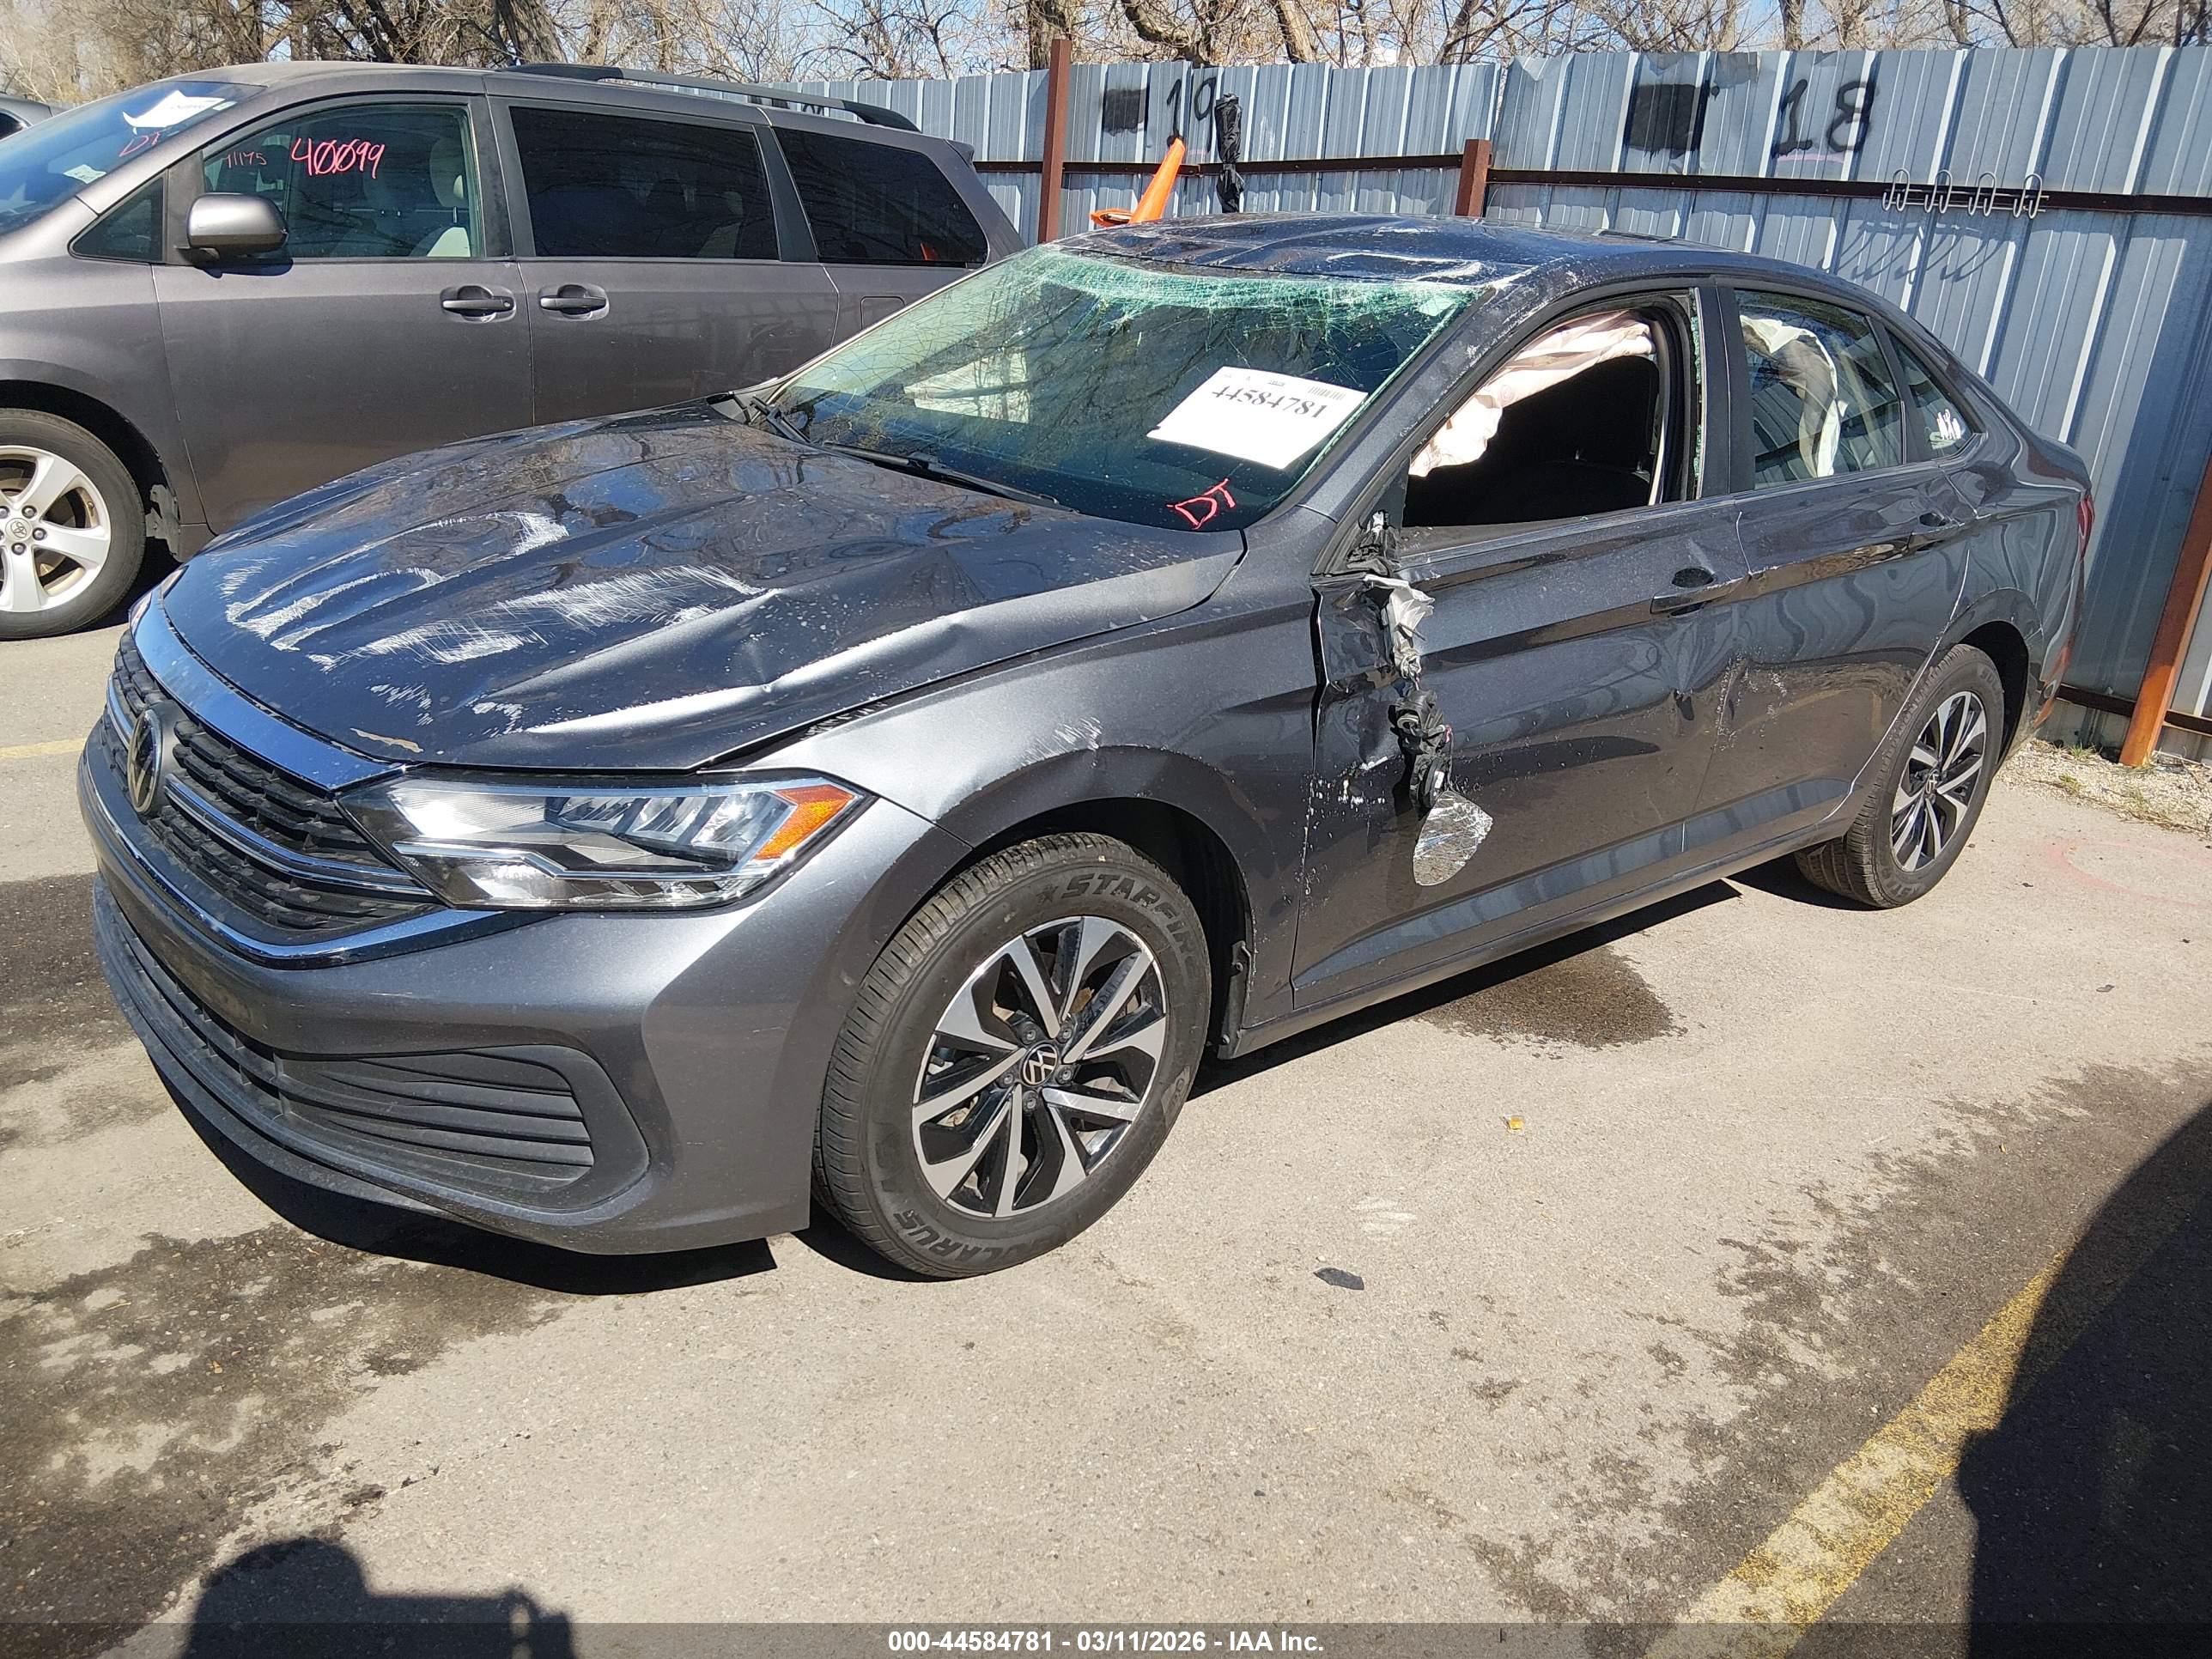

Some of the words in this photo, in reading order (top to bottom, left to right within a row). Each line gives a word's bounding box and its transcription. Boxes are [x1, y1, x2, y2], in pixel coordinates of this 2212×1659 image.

[1166, 78, 1217, 153] 19
[1771, 78, 1875, 158] 18
[291, 137, 386, 179] 40099
[1212, 386, 1328, 418] 44584781
[1166, 477, 1236, 530] DT
